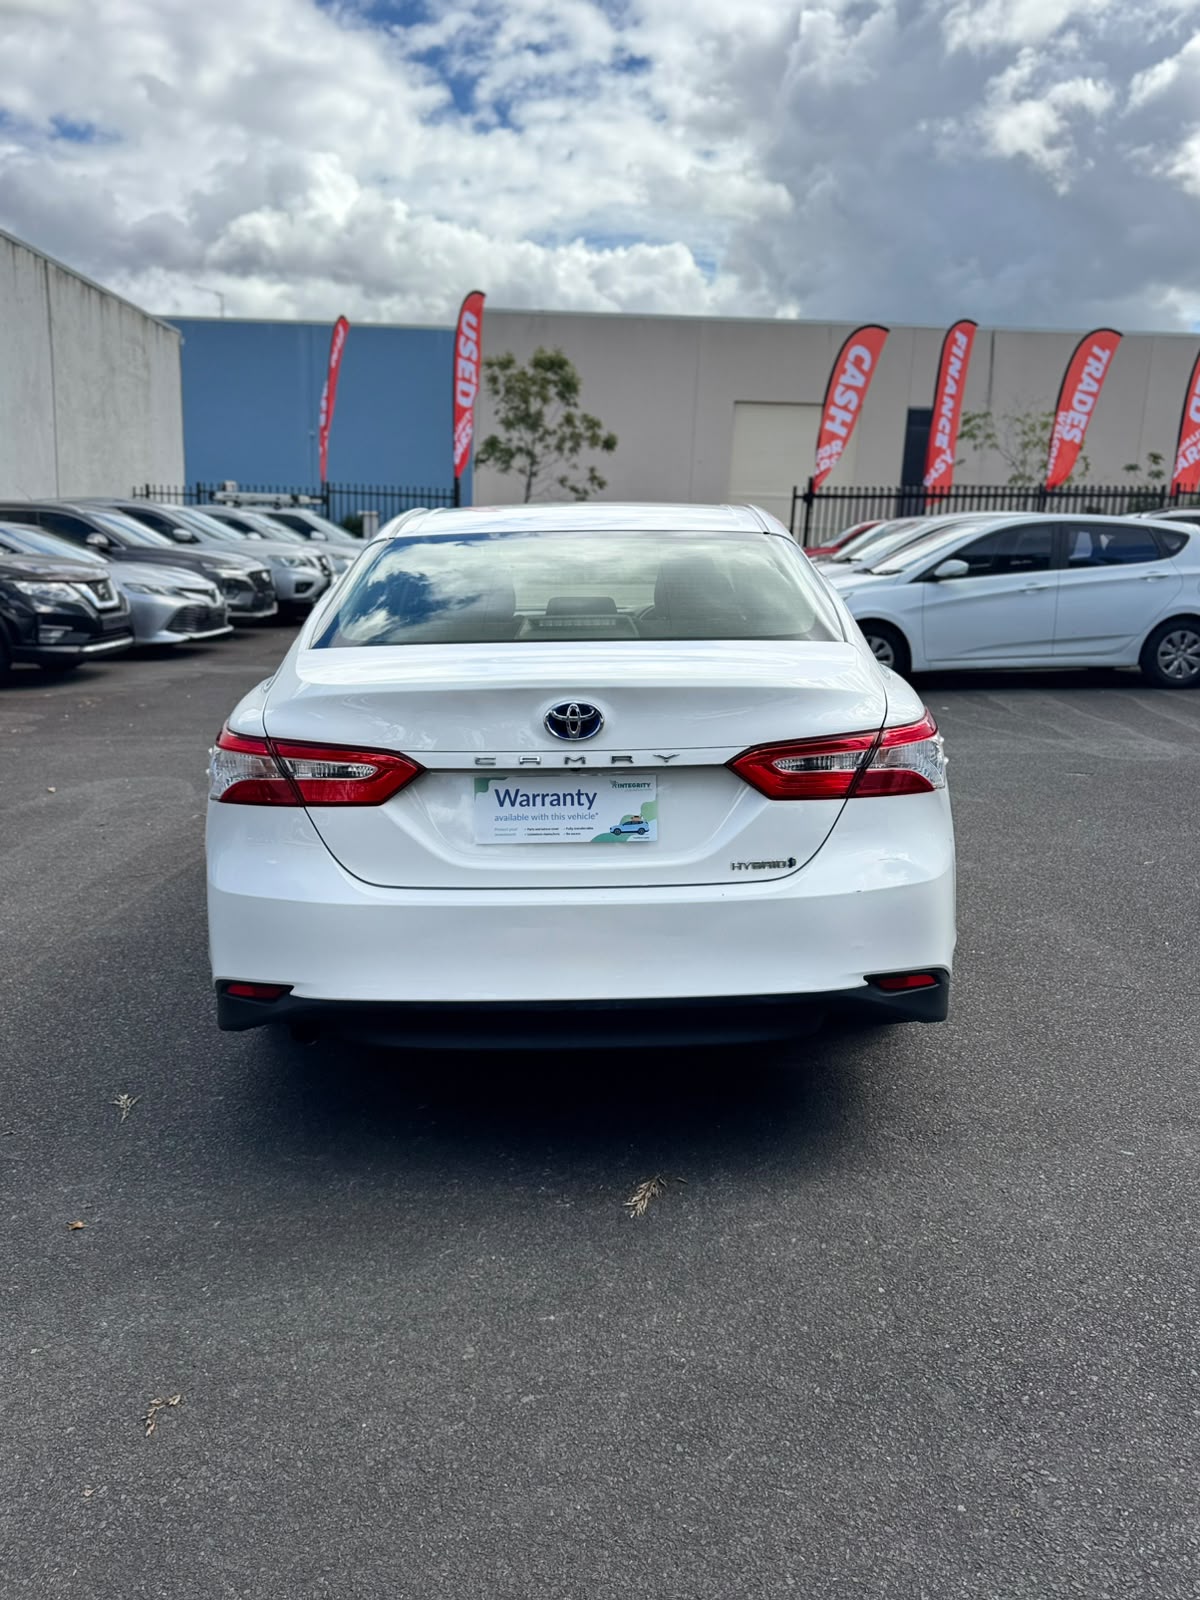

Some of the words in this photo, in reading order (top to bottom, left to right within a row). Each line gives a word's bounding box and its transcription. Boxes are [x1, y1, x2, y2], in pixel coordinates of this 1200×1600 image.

[456, 310, 478, 408] USED
[823, 344, 872, 438] CASH
[934, 331, 969, 449] FINANCE
[1062, 345, 1111, 444] TRADES
[474, 753, 681, 766] CAMRY
[494, 788, 598, 810] Warranty
[494, 813, 529, 822] available
[530, 812, 549, 821] with
[550, 812, 566, 821] this
[731, 860, 787, 871] HYBRID
